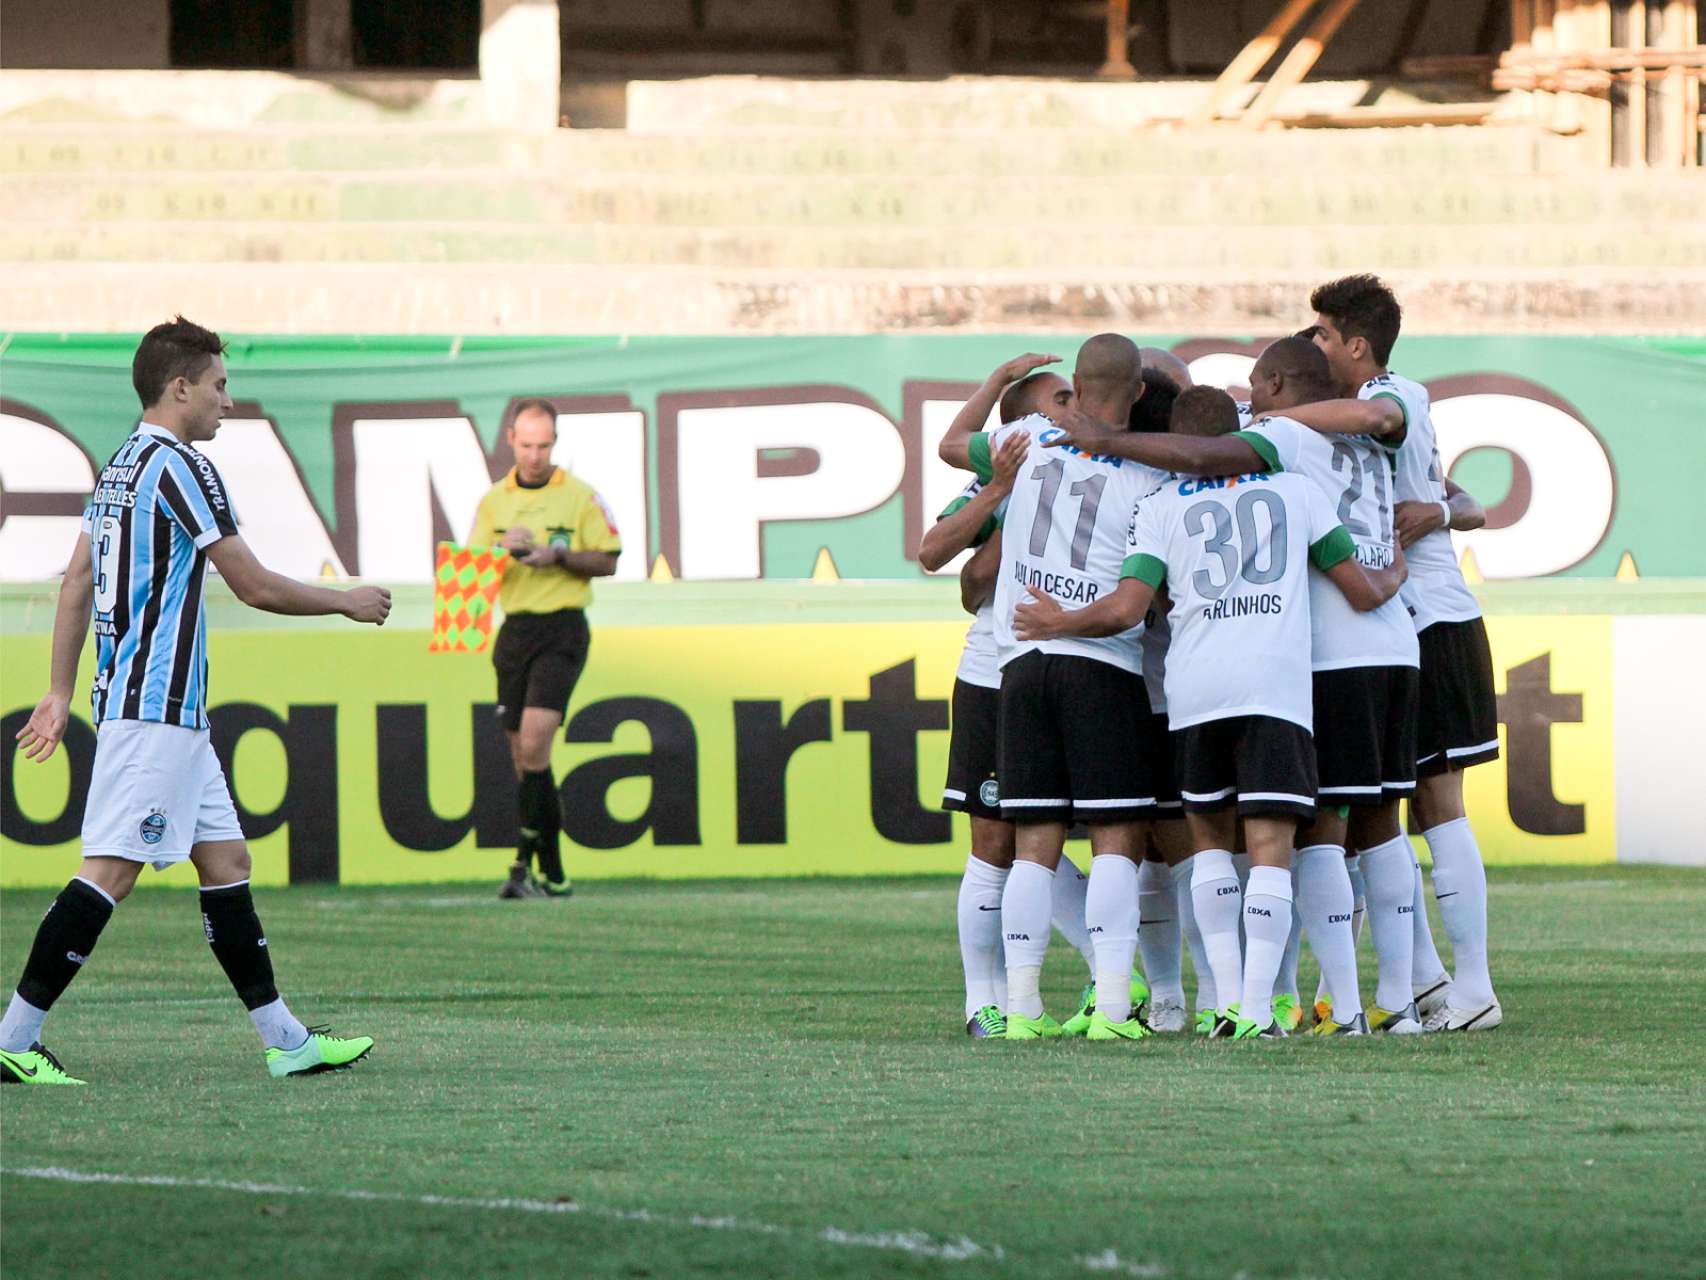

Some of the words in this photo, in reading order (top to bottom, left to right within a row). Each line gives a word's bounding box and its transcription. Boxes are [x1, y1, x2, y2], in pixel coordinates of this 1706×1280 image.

[1029, 458, 1108, 571] 11
[1183, 488, 1289, 601] 30
[1331, 441, 1393, 545] 21
[1044, 573, 1099, 604] CESAR
